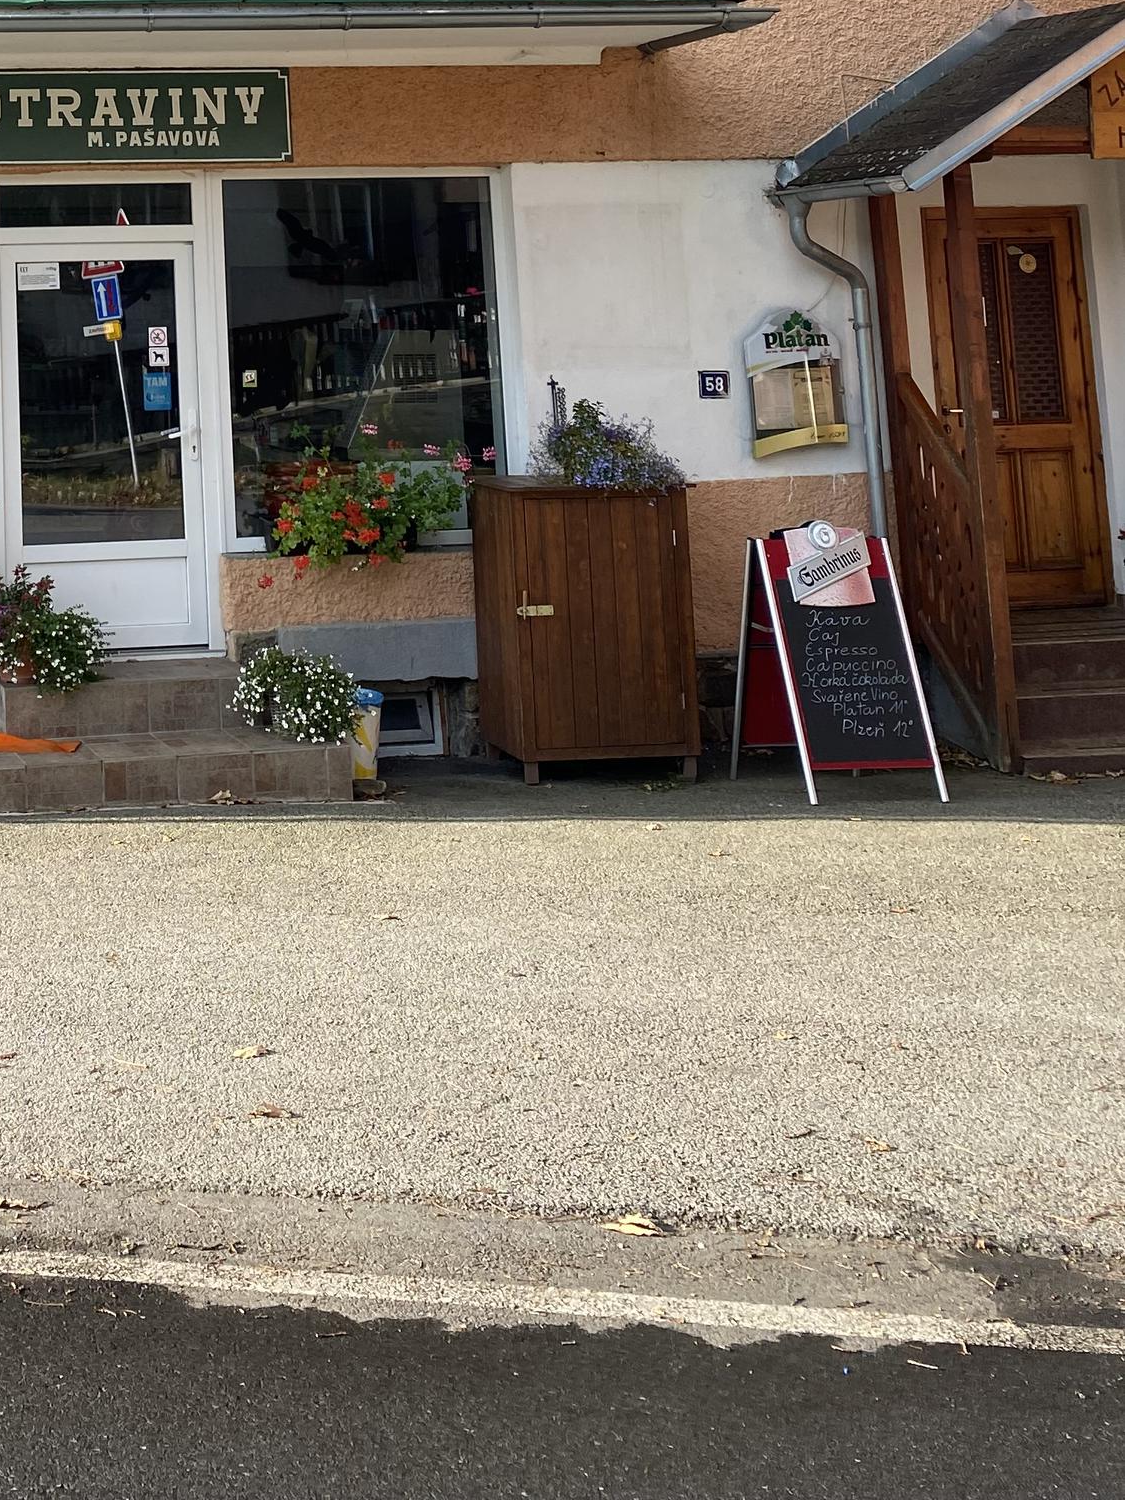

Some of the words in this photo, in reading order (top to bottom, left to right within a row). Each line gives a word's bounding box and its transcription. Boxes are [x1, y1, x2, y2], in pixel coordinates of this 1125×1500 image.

[115, 127, 221, 148] PAŠAVOVÁ
[705, 376, 724, 392] 58
[798, 548, 862, 587] Gambrinus
[805, 642, 878, 661] Espresso
[805, 657, 896, 677] Capuccino
[833, 701, 885, 717] Platan
[842, 718, 885, 737] Plzeň
